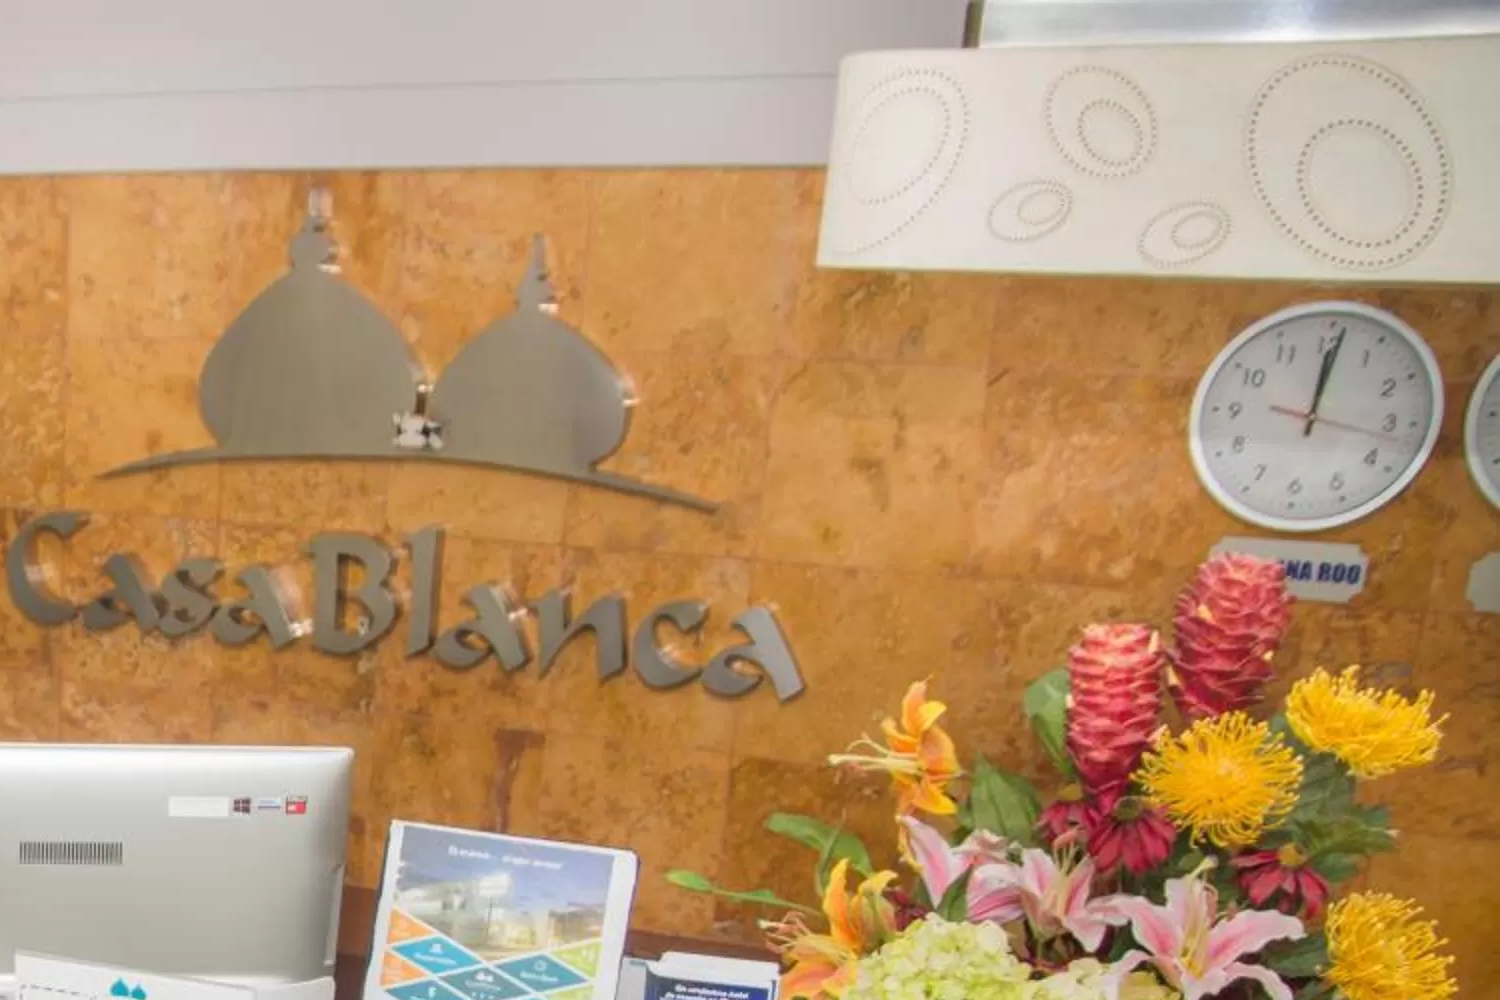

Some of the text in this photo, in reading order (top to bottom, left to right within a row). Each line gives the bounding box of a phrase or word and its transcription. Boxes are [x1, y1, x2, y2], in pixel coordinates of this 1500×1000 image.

[1275, 343, 1297, 367] 11
[1362, 349, 1372, 369] 1
[1242, 367, 1267, 389] 10
[1380, 377, 1397, 399] 2
[1228, 401, 1243, 420] 9
[1381, 412, 1398, 433] 3
[1232, 435, 1246, 454] 8
[1364, 447, 1379, 467] 4
[1253, 463, 1268, 482] 7
[1287, 477, 1304, 495] 6
[1316, 561, 1362, 585] ROO
[2, 508, 807, 704] CasaBlanca
